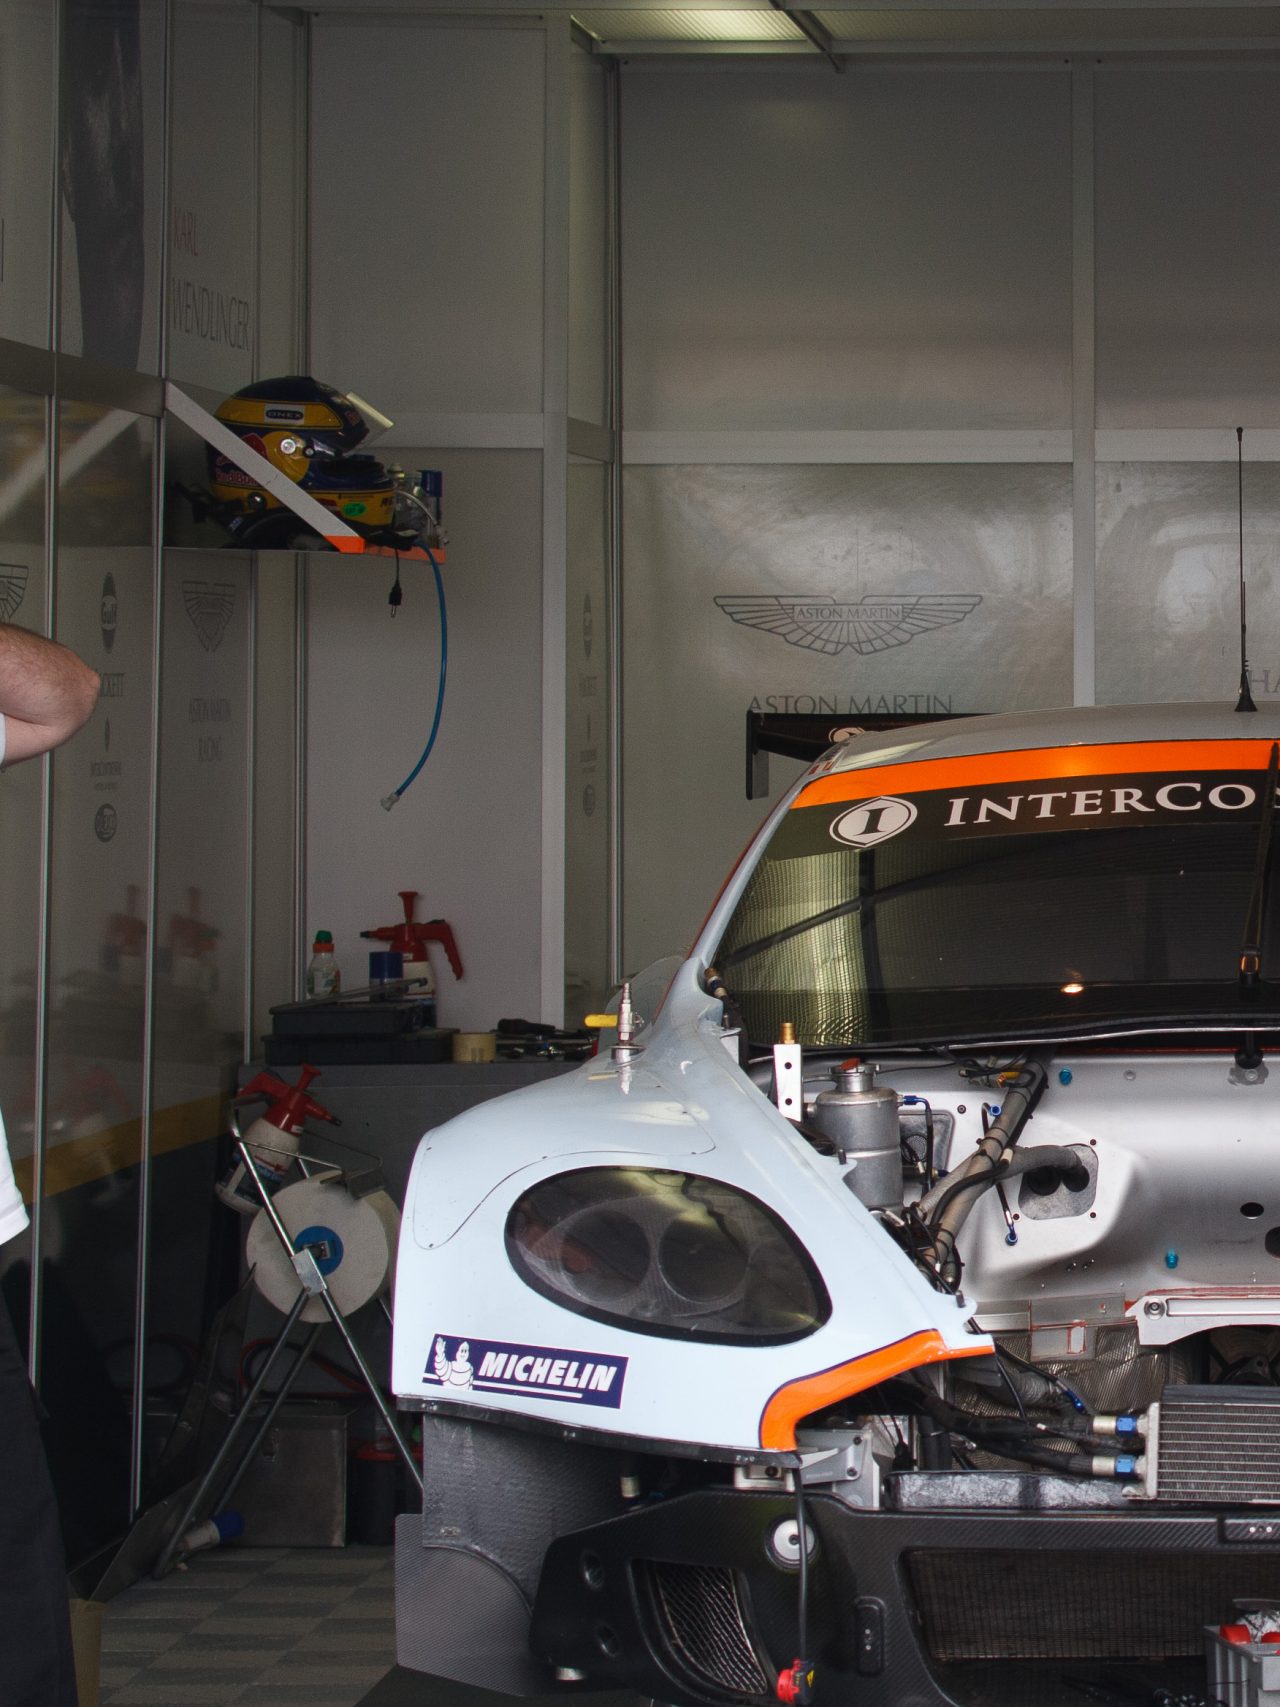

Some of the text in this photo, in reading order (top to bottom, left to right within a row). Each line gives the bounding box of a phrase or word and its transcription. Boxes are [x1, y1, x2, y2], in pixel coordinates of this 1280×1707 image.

[173, 277, 249, 352] WENDLINGER
[796, 607, 899, 619] ASTON MARTIN
[748, 695, 951, 714] ASTON MARTIN
[478, 1351, 618, 1392] MICHELIN
